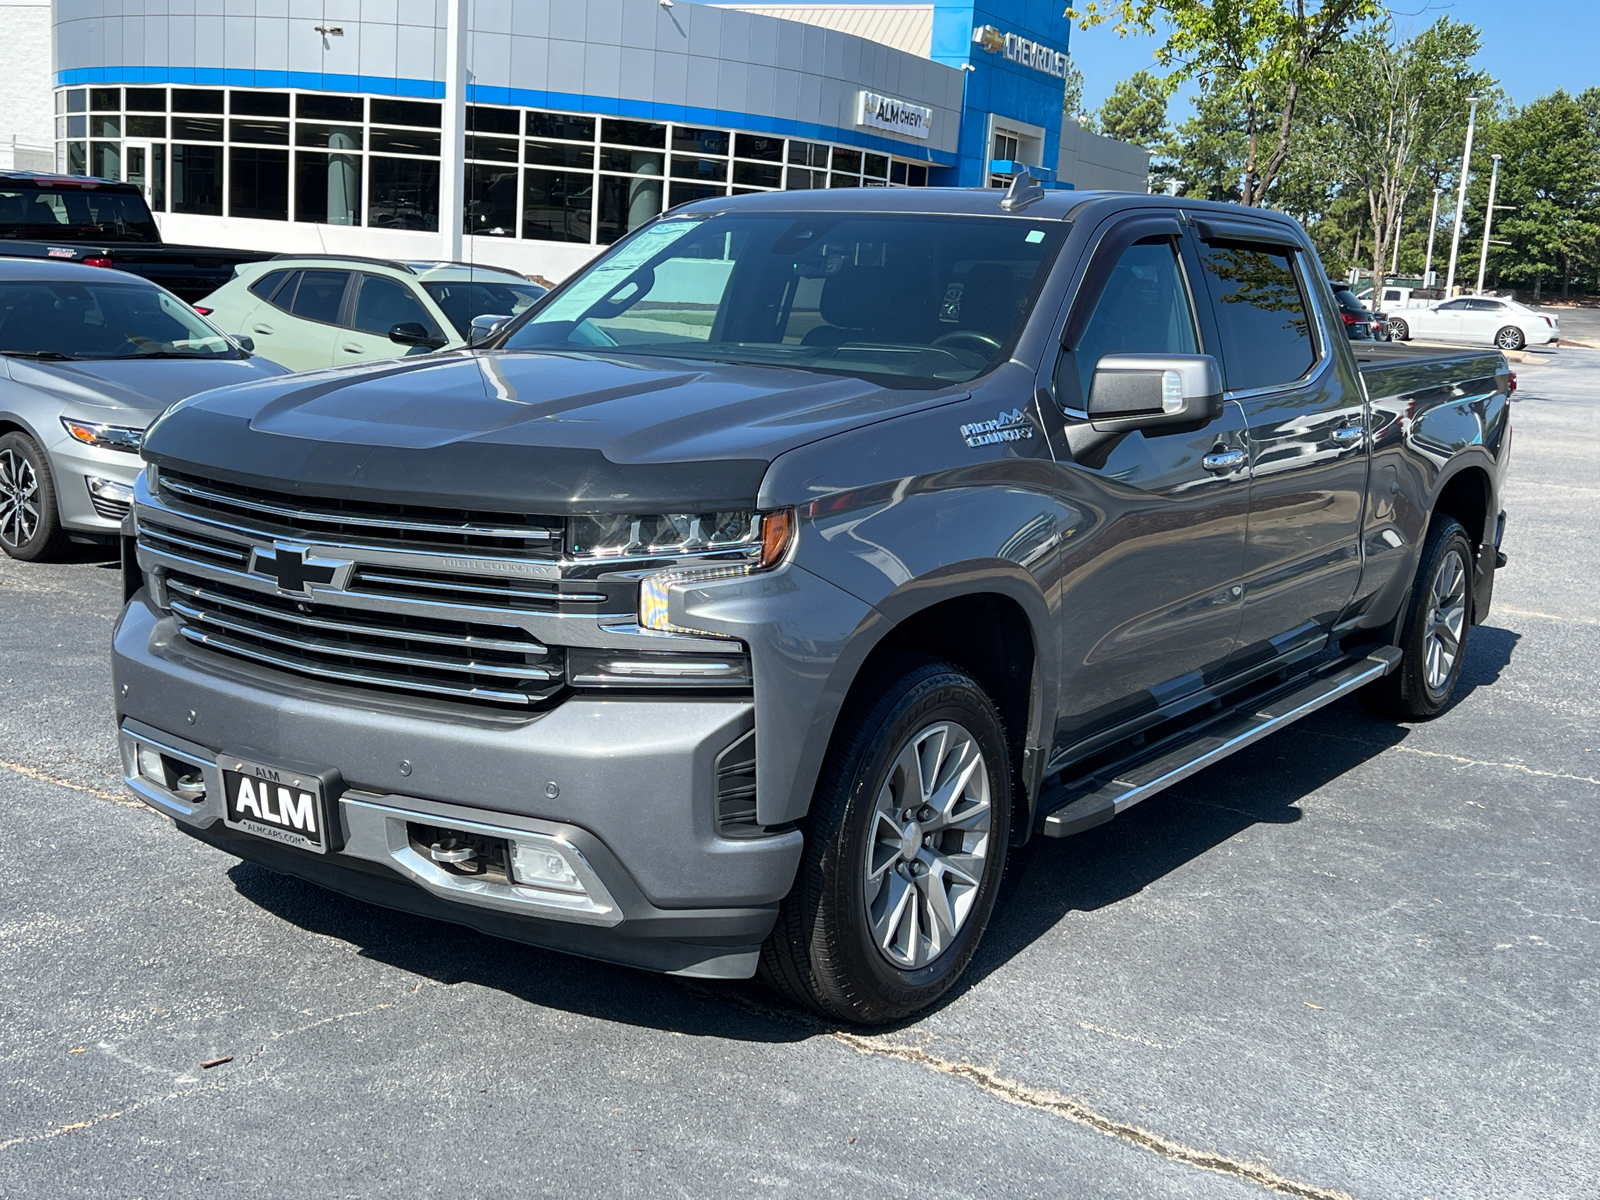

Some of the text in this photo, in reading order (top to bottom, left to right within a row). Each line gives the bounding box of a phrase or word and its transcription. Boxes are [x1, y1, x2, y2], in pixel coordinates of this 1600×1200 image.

[1004, 32, 1069, 79] CHEVROLET
[876, 102, 923, 129] ALM CHEVY
[960, 419, 1001, 437] HIGH
[965, 426, 1034, 449] COUNTRY
[443, 558, 551, 575] HIGH COUNTRY
[255, 766, 281, 783] ALM
[235, 777, 317, 833] ALM
[247, 823, 302, 845] ALMCARS.COM
